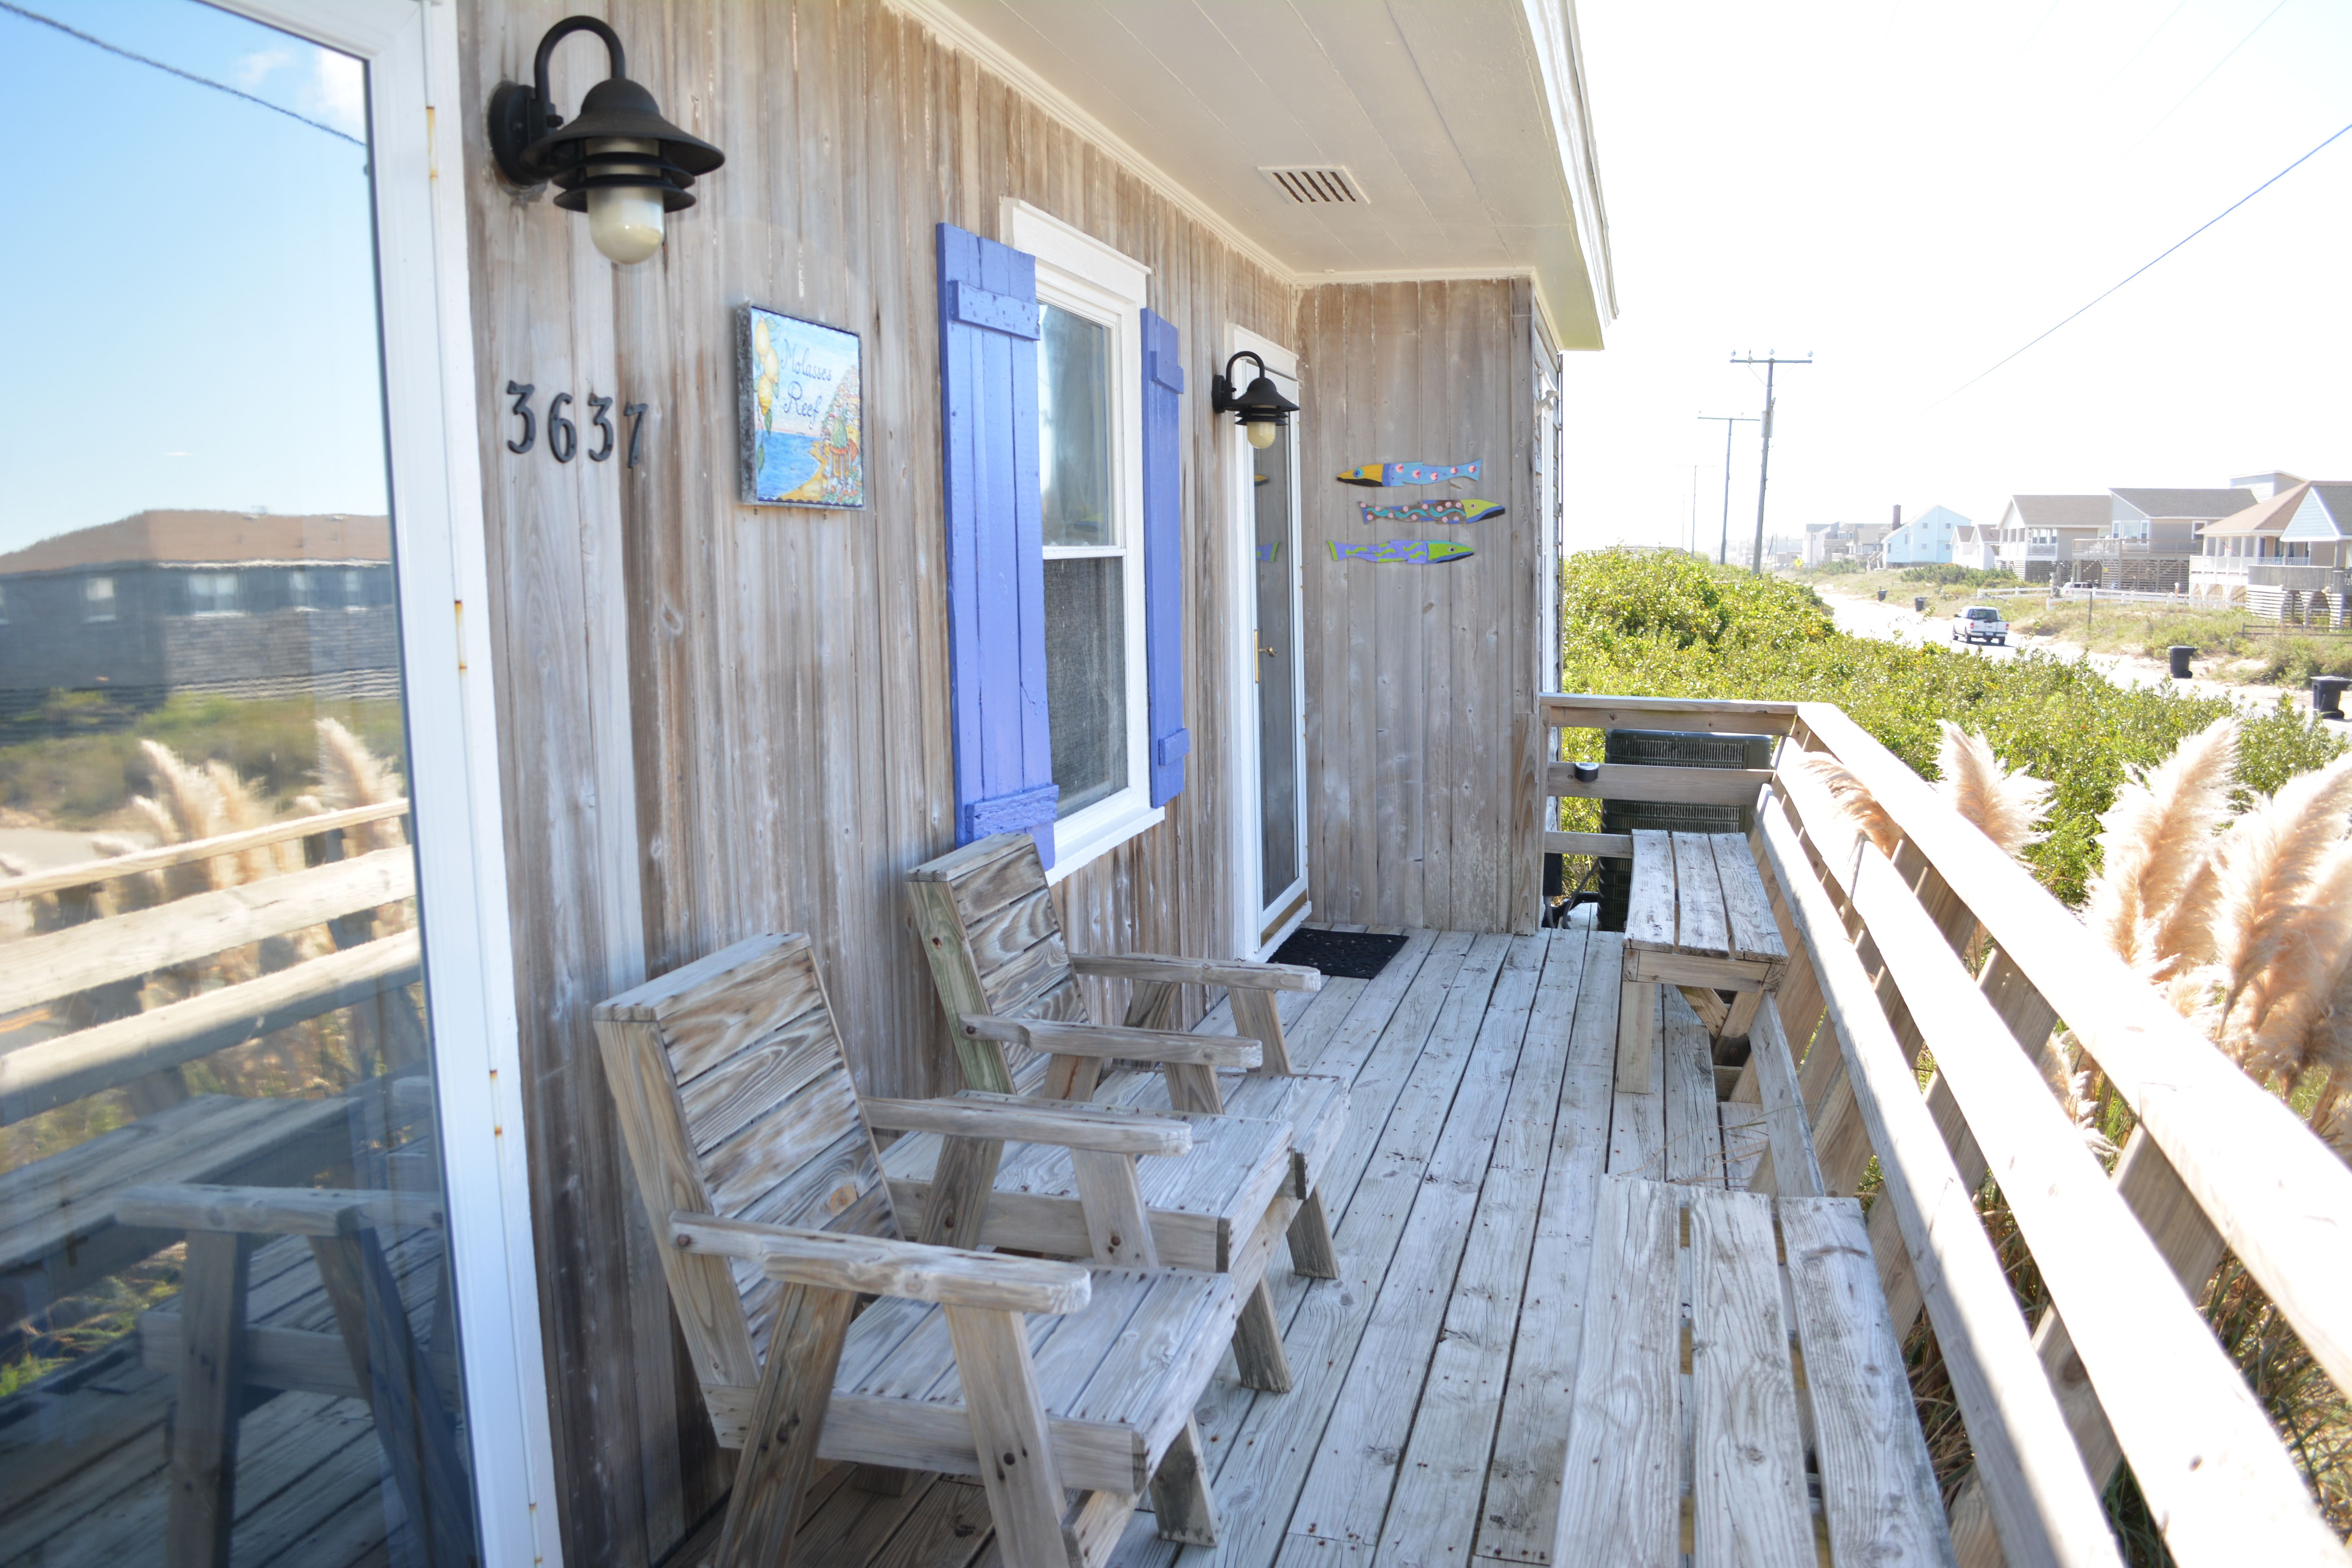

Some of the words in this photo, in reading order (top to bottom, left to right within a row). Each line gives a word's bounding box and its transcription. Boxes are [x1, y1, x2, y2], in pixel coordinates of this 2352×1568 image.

[781, 338, 832, 381] Molasses
[506, 380, 648, 468] 3637
[784, 381, 822, 429] Reef
